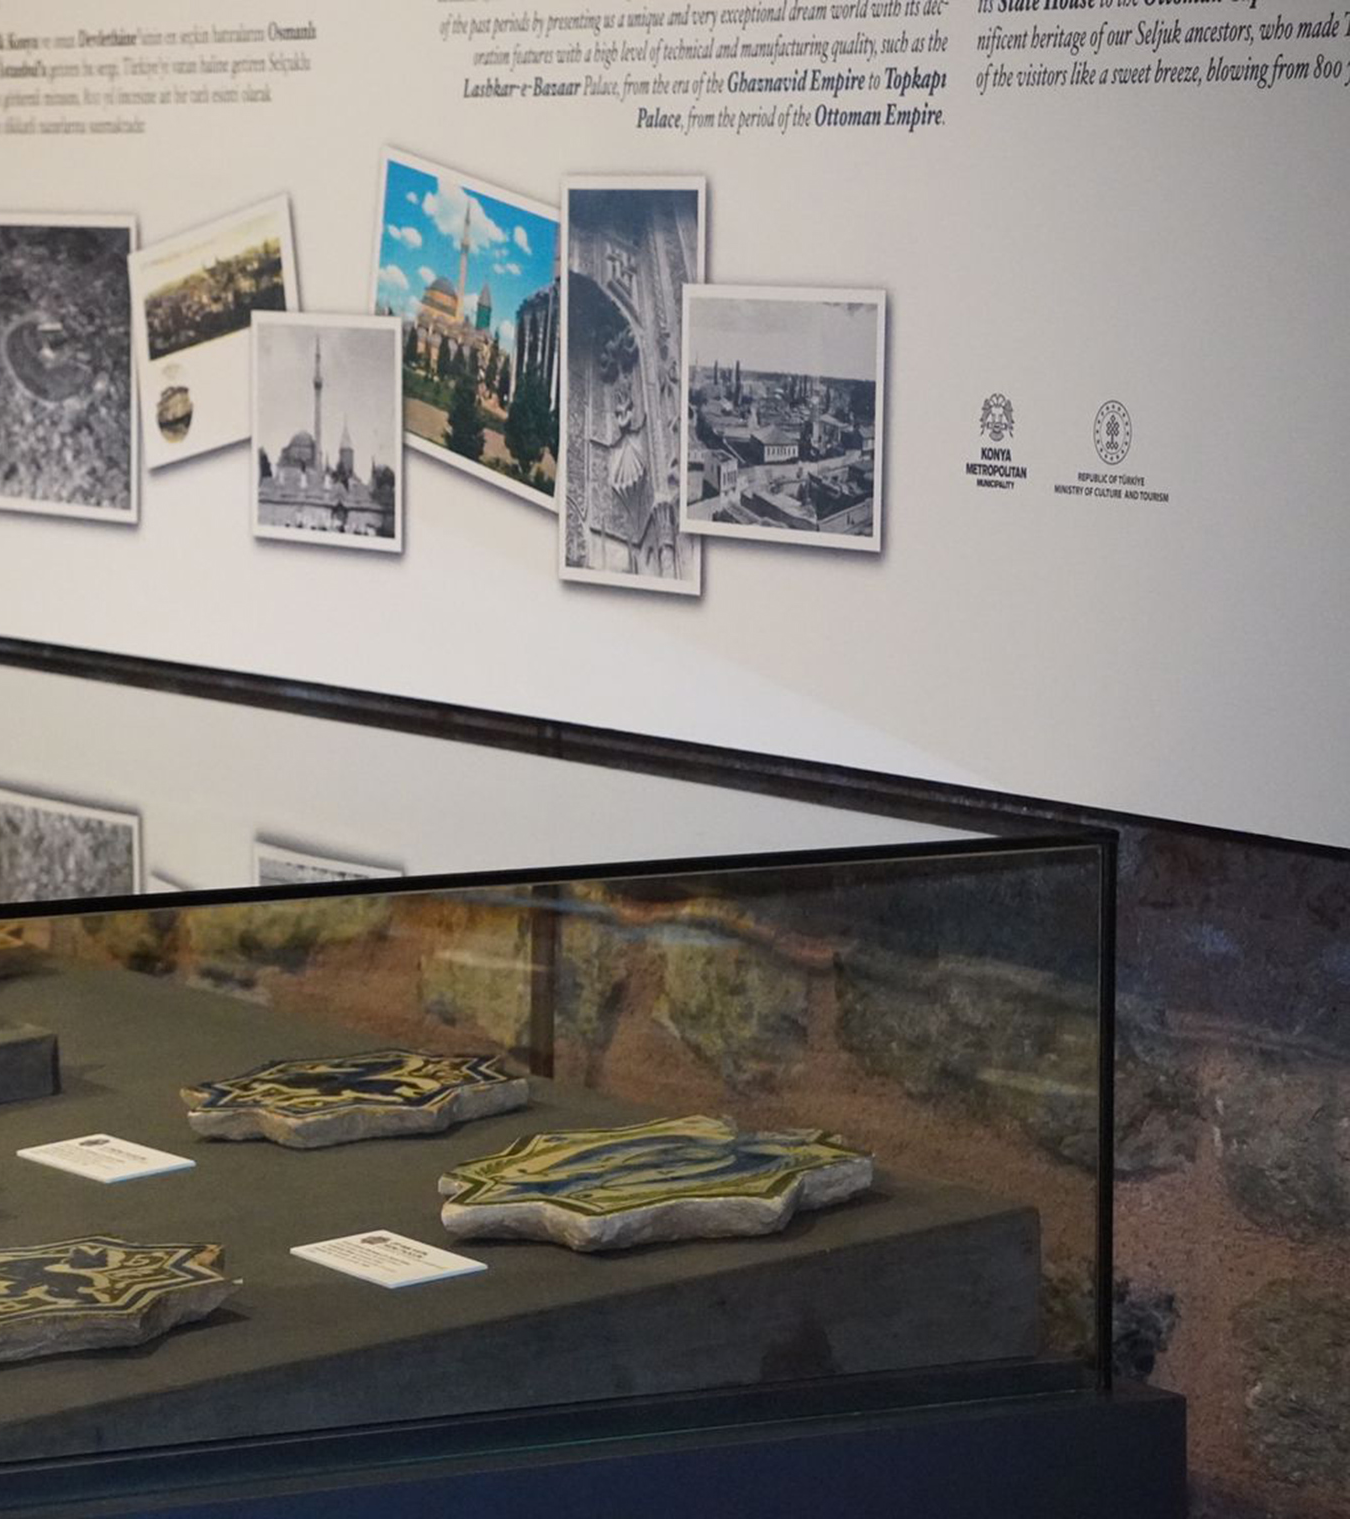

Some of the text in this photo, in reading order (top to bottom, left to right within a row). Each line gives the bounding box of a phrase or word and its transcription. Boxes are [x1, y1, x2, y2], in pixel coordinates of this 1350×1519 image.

[452, 14, 468, 35] the
[468, 17, 491, 41] past
[492, 11, 530, 40] periods
[532, 11, 544, 39] by
[545, 9, 601, 37] presenting
[603, 14, 616, 29] us
[617, 14, 625, 28] a
[627, 6, 665, 34] unique
[667, 3, 691, 26] and
[692, 10, 718, 32] very
[720, 0, 787, 31] exceptional
[788, 0, 827, 21] dream
[831, 0, 868, 18] world
[871, 0, 902, 17] with
[904, 0, 920, 16] its
[922, 0, 950, 16] dec-
[977, 25, 1028, 58] nificent
[1030, 24, 1087, 56] heritage
[1089, 21, 1108, 55] of
[1107, 29, 1133, 46] our
[1135, 19, 1181, 53] Seljuk
[1184, 22, 1254, 46] ancestors,
[1259, 14, 1293, 40] who
[1296, 12, 1340, 39] made
[473, 29, 949, 72] oration features with a high level of technical and manufacturing quality, such as the
[463, 66, 947, 102] Lashkar-e-Bazaar Palace, from the era of the Ghaznavid Empire to Topkapı
[976, 63, 993, 96] of
[992, 63, 1013, 88] the
[1016, 63, 1068, 87] visitors
[1070, 61, 1096, 86] like
[1099, 68, 1107, 85] a
[1111, 64, 1152, 85] sweet
[1154, 59, 1202, 86] breeze,
[1206, 56, 1268, 89] blowing
[1267, 54, 1310, 88] from
[1313, 54, 1342, 79] 800
[636, 102, 946, 135] Palace, from the period of the Ottoman Empire.
[966, 462, 1027, 479] METROPOLITAN
[981, 447, 1012, 462] KONYA
[976, 478, 1014, 490] MUNICIPALITY
[1054, 484, 1169, 502] MINISTRY OF CULTURE AND TOURISM
[1077, 472, 1108, 484] REPUBLIC
[1109, 474, 1118, 485] OF
